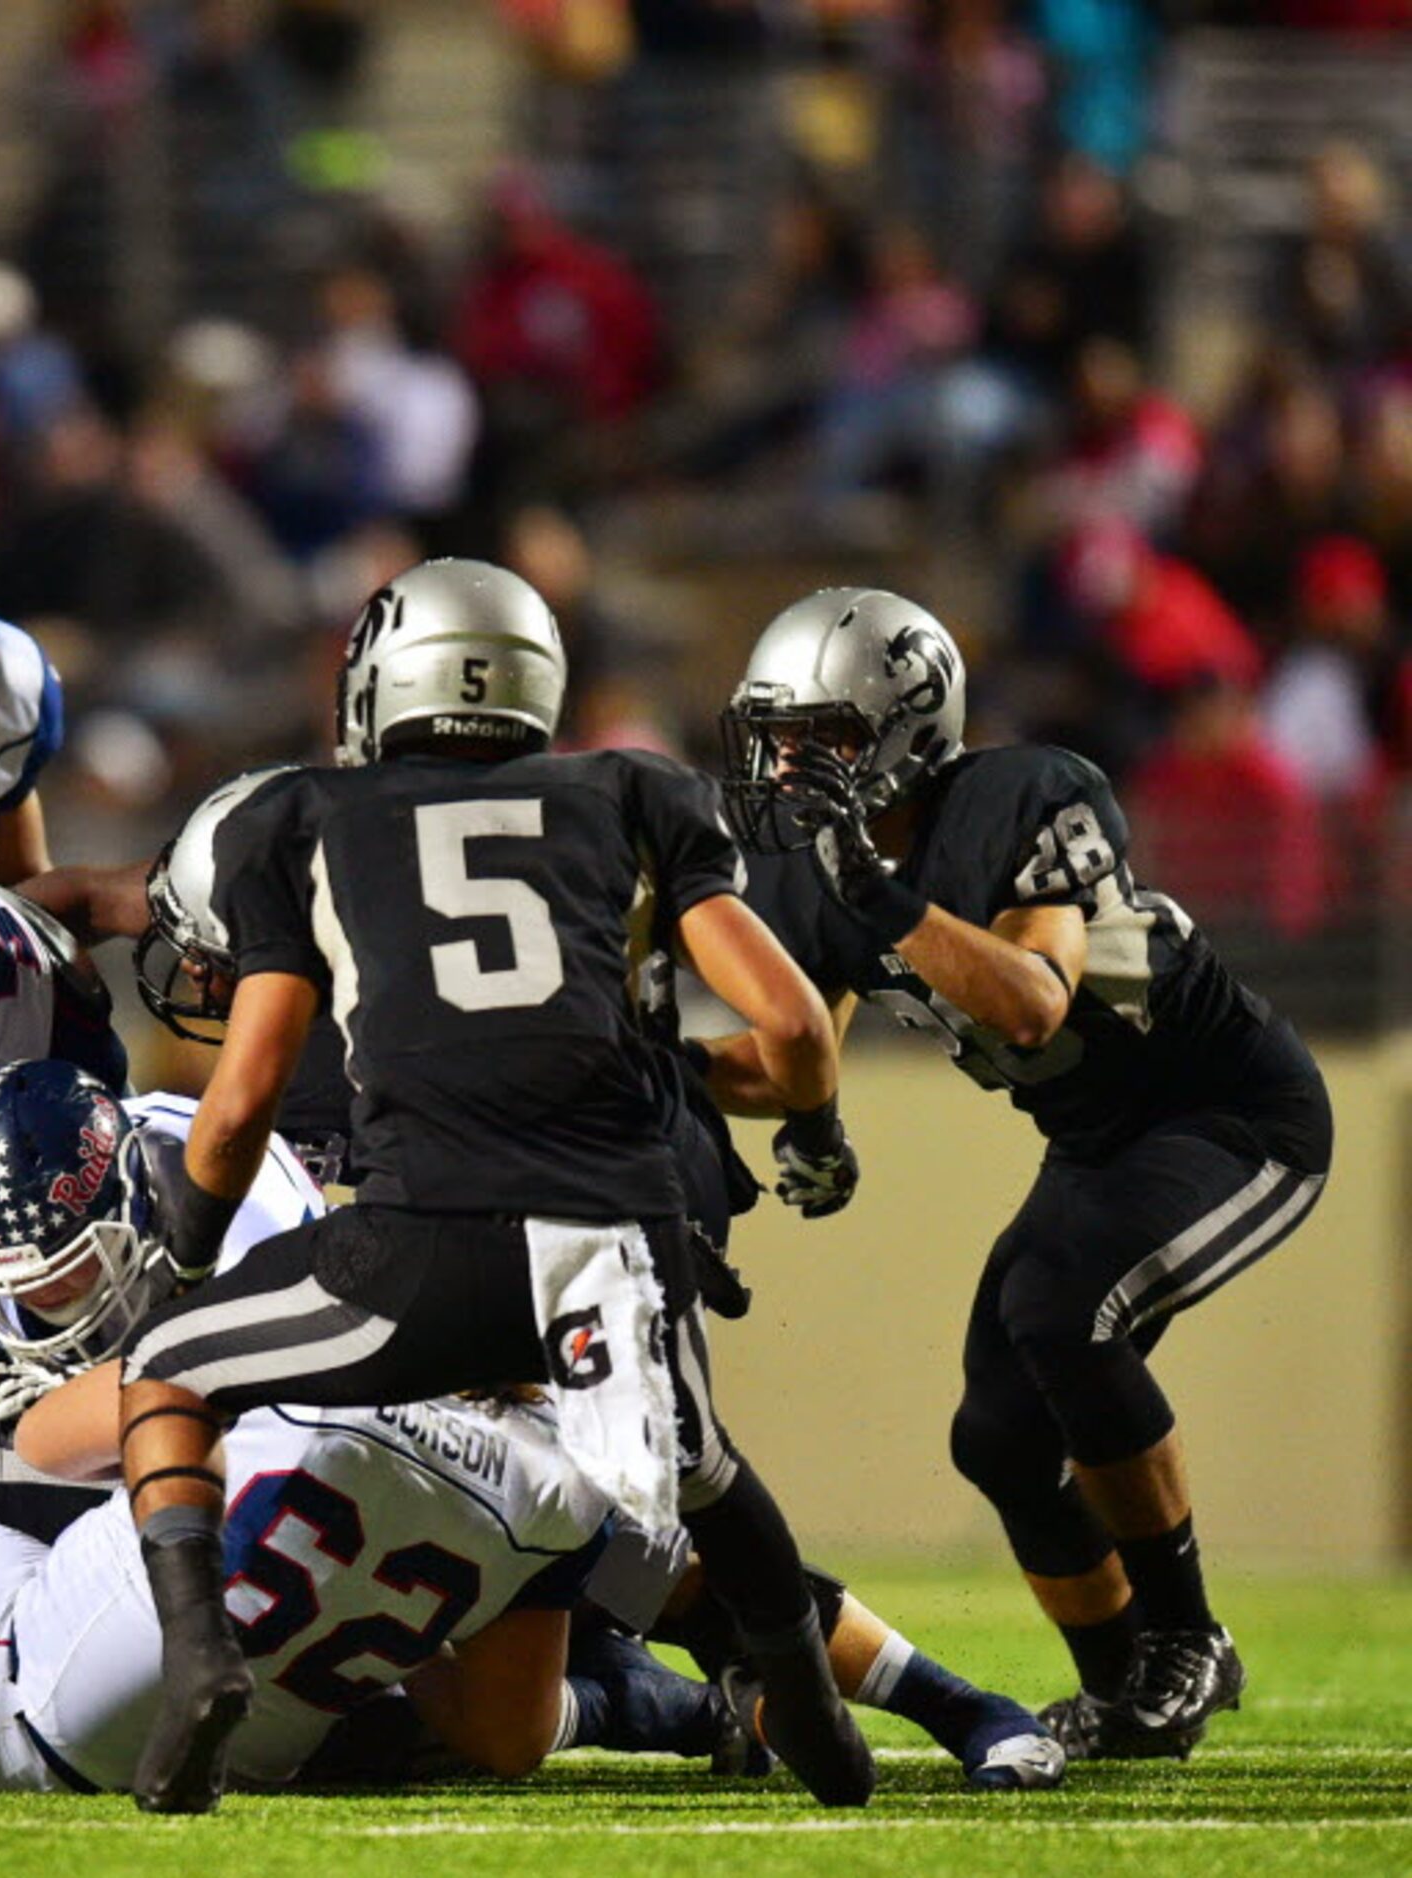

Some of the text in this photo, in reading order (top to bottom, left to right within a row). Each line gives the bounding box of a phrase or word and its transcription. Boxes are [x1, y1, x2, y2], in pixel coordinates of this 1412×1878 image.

[459, 658, 490, 704] 5
[414, 797, 565, 1013] 5
[1013, 801, 1117, 900] 28
[221, 1466, 483, 1714] 62
